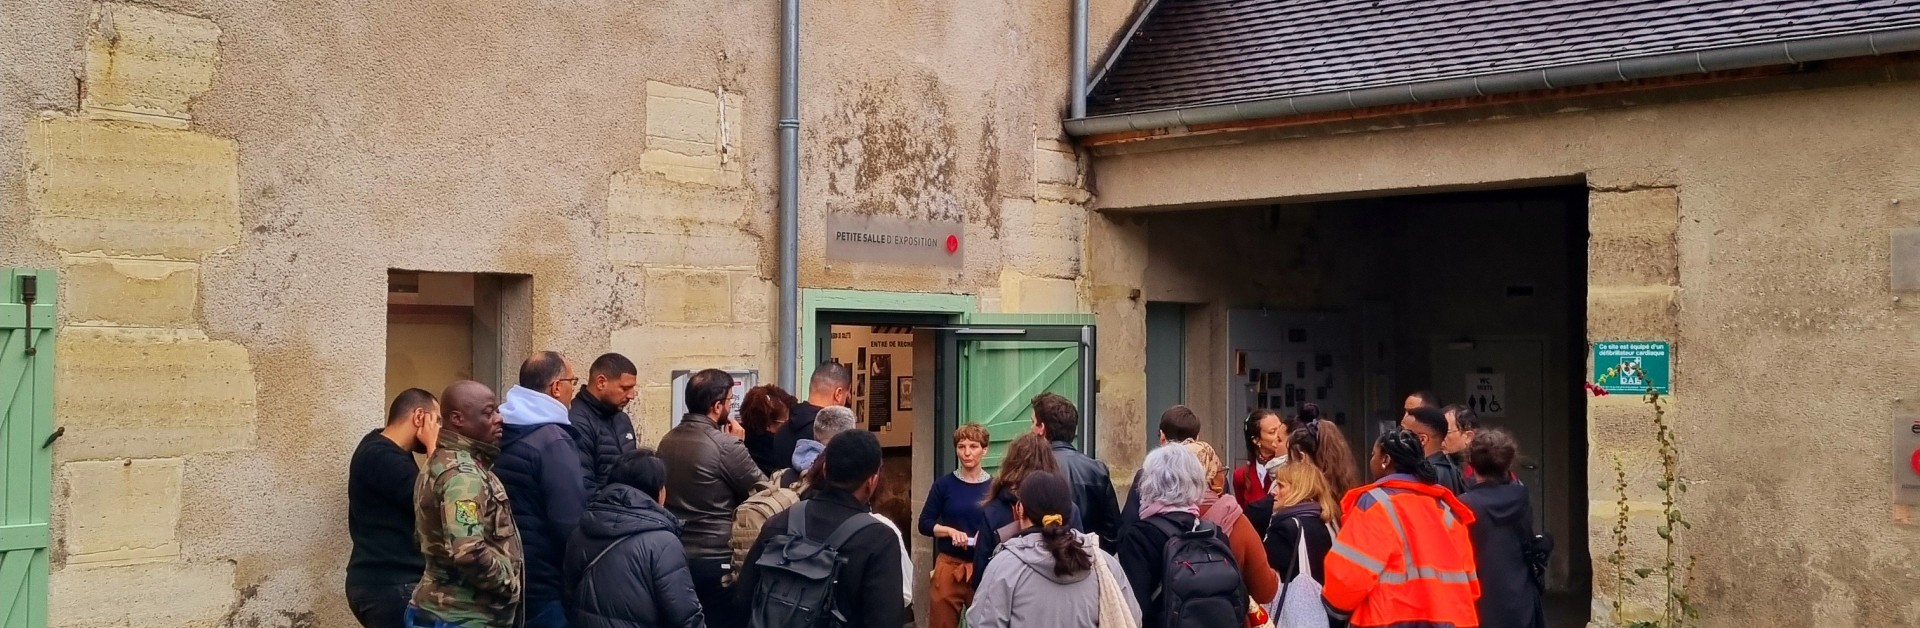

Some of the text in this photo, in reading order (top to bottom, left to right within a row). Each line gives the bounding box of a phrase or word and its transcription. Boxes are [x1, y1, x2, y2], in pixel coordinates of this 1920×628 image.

[836, 231, 938, 247] PETITE SALLE D'EXPOSITION
